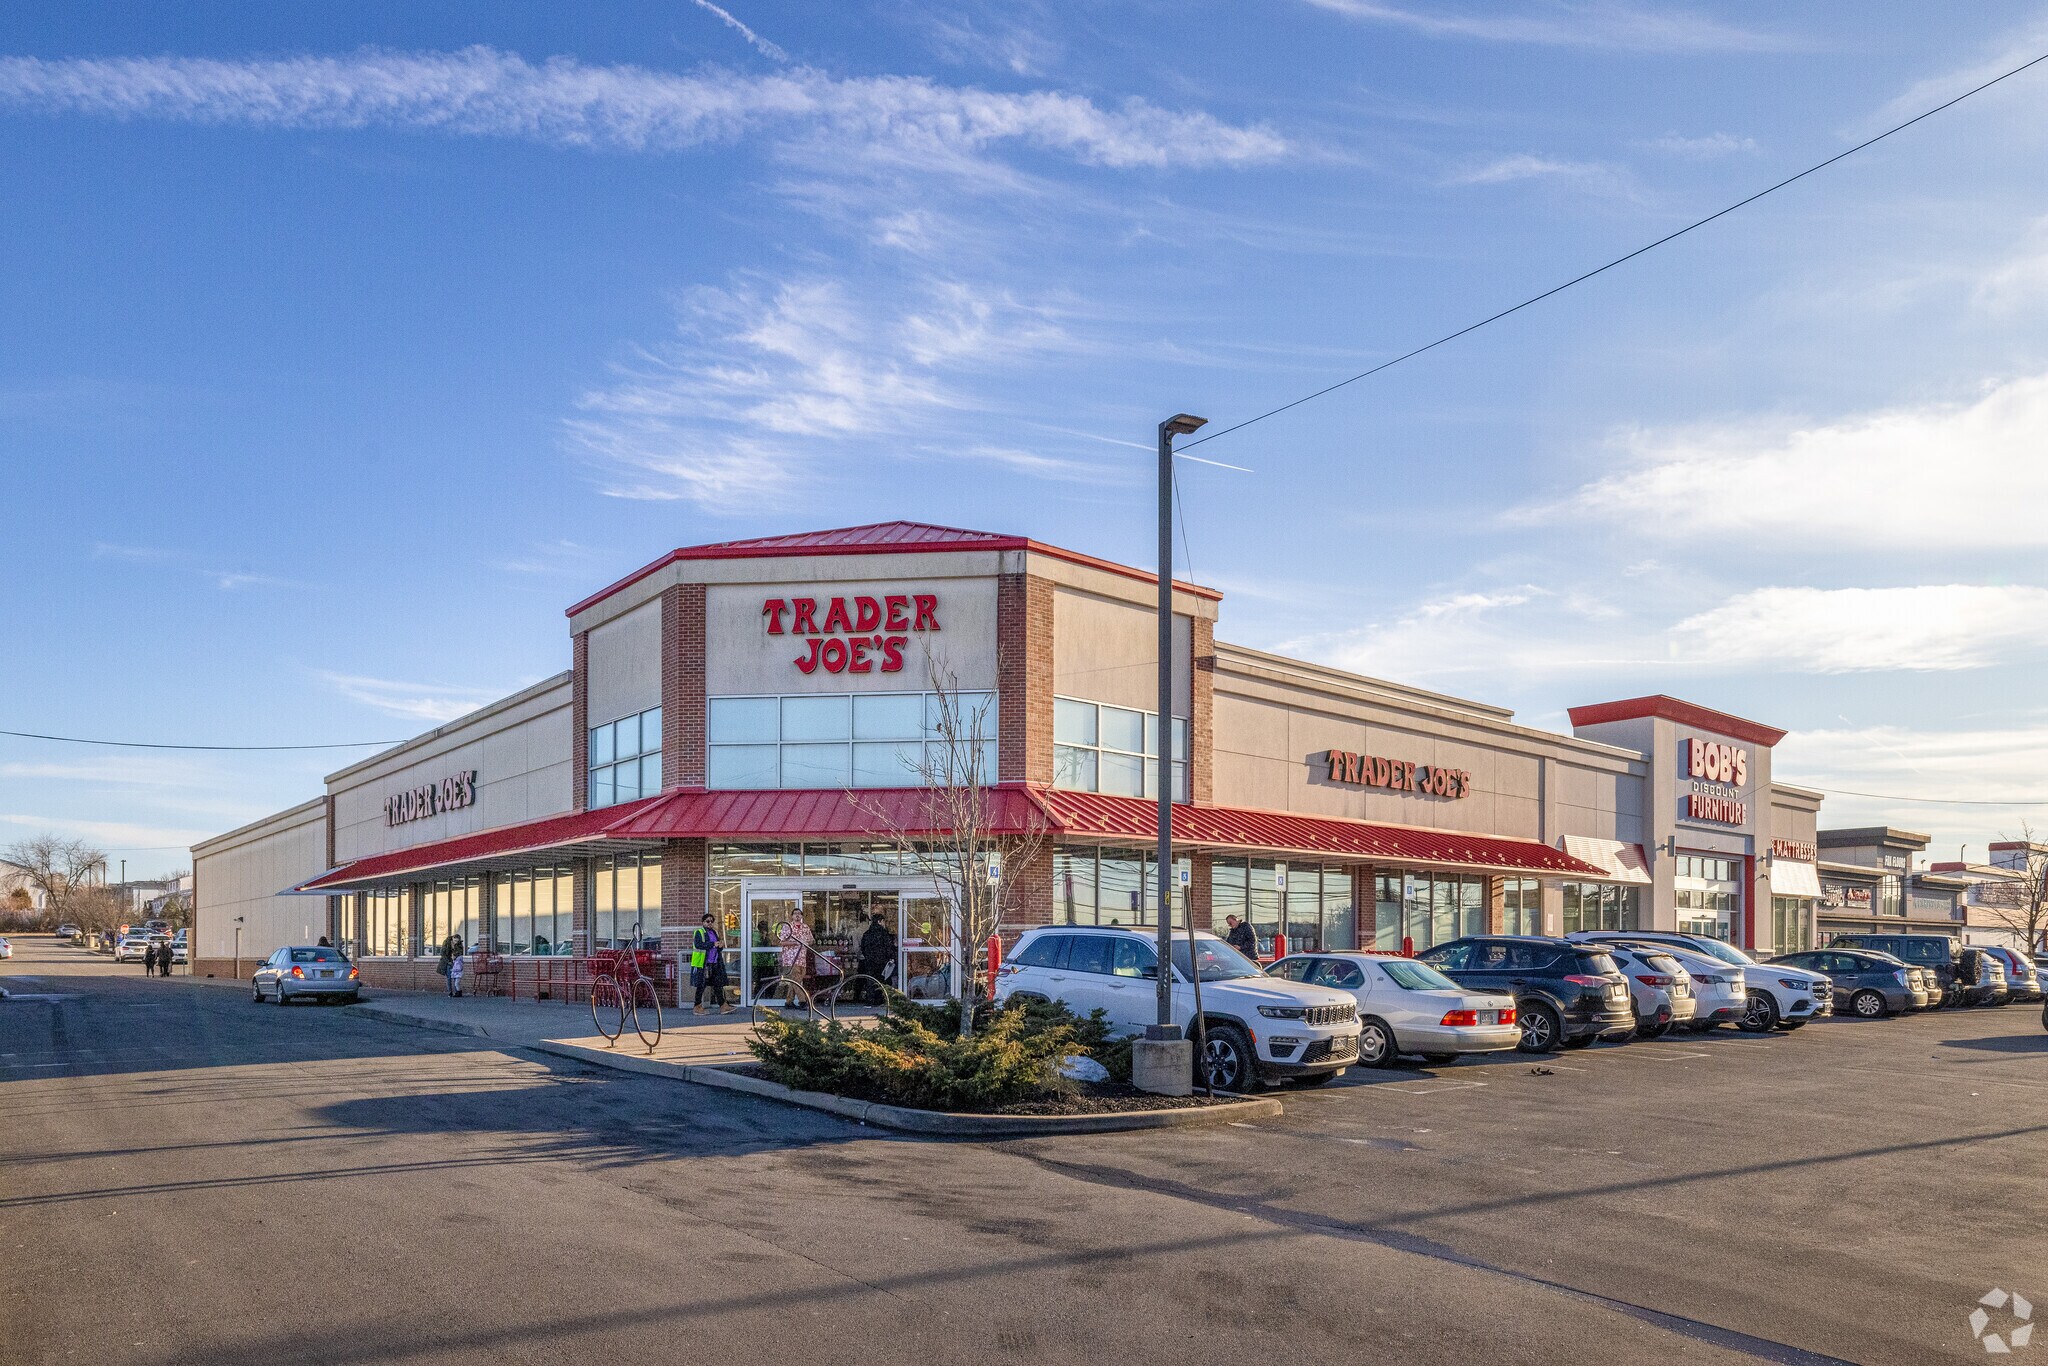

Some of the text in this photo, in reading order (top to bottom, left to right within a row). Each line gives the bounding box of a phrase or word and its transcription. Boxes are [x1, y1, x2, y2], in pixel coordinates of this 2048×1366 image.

[762, 594, 941, 635] TRADER
[793, 634, 908, 674] JOE'S
[1327, 749, 1472, 798] TRADER JOE'S
[1690, 738, 1747, 787] BOB'S
[384, 770, 476, 828] TRADER JOE'S
[1690, 795, 1747, 825] FURNITURE
[1692, 781, 1739, 800] DISCOUNT
[1776, 839, 1817, 861] MATTRESSES
